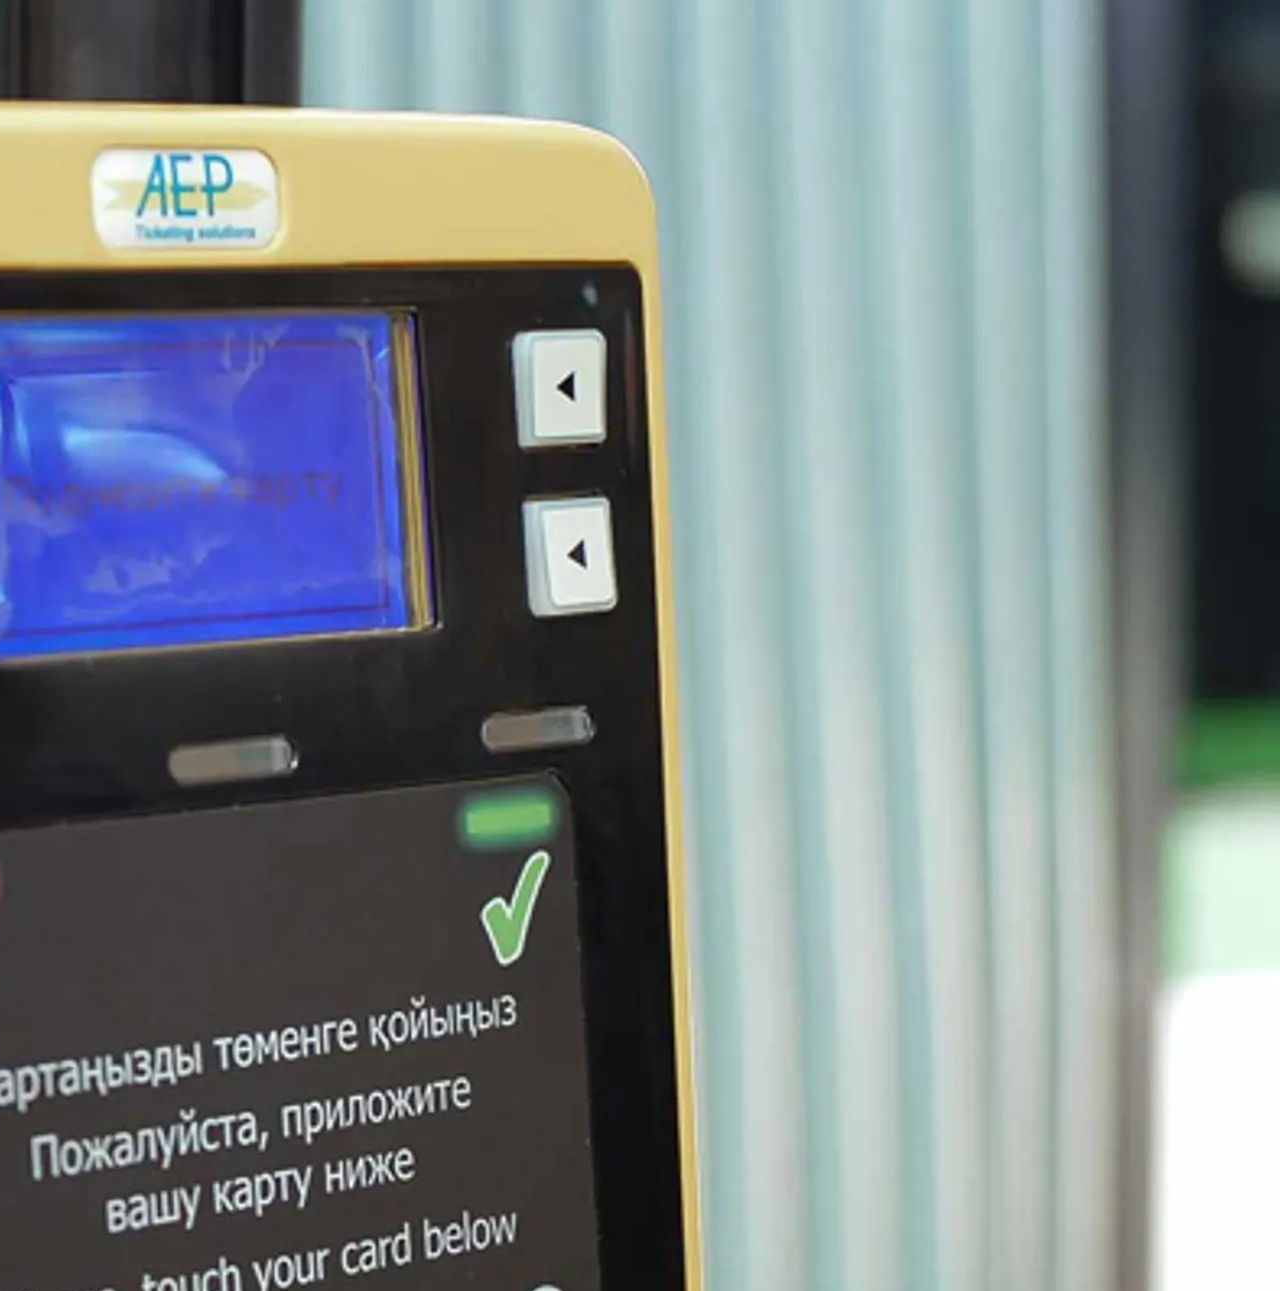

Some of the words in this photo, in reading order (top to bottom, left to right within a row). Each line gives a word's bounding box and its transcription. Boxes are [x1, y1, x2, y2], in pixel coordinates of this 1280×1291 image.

[135, 153, 234, 217] AEP
[214, 1016, 358, 1070] төменге
[369, 994, 517, 1052] қойыңыз
[30, 1108, 270, 1180] Пожалуйста,
[281, 1076, 471, 1145] приложите
[106, 1185, 201, 1233] вашу
[212, 1165, 313, 1217] карту
[324, 1147, 415, 1194] ниже
[341, 1221, 412, 1275] card
[423, 1211, 517, 1260] below
